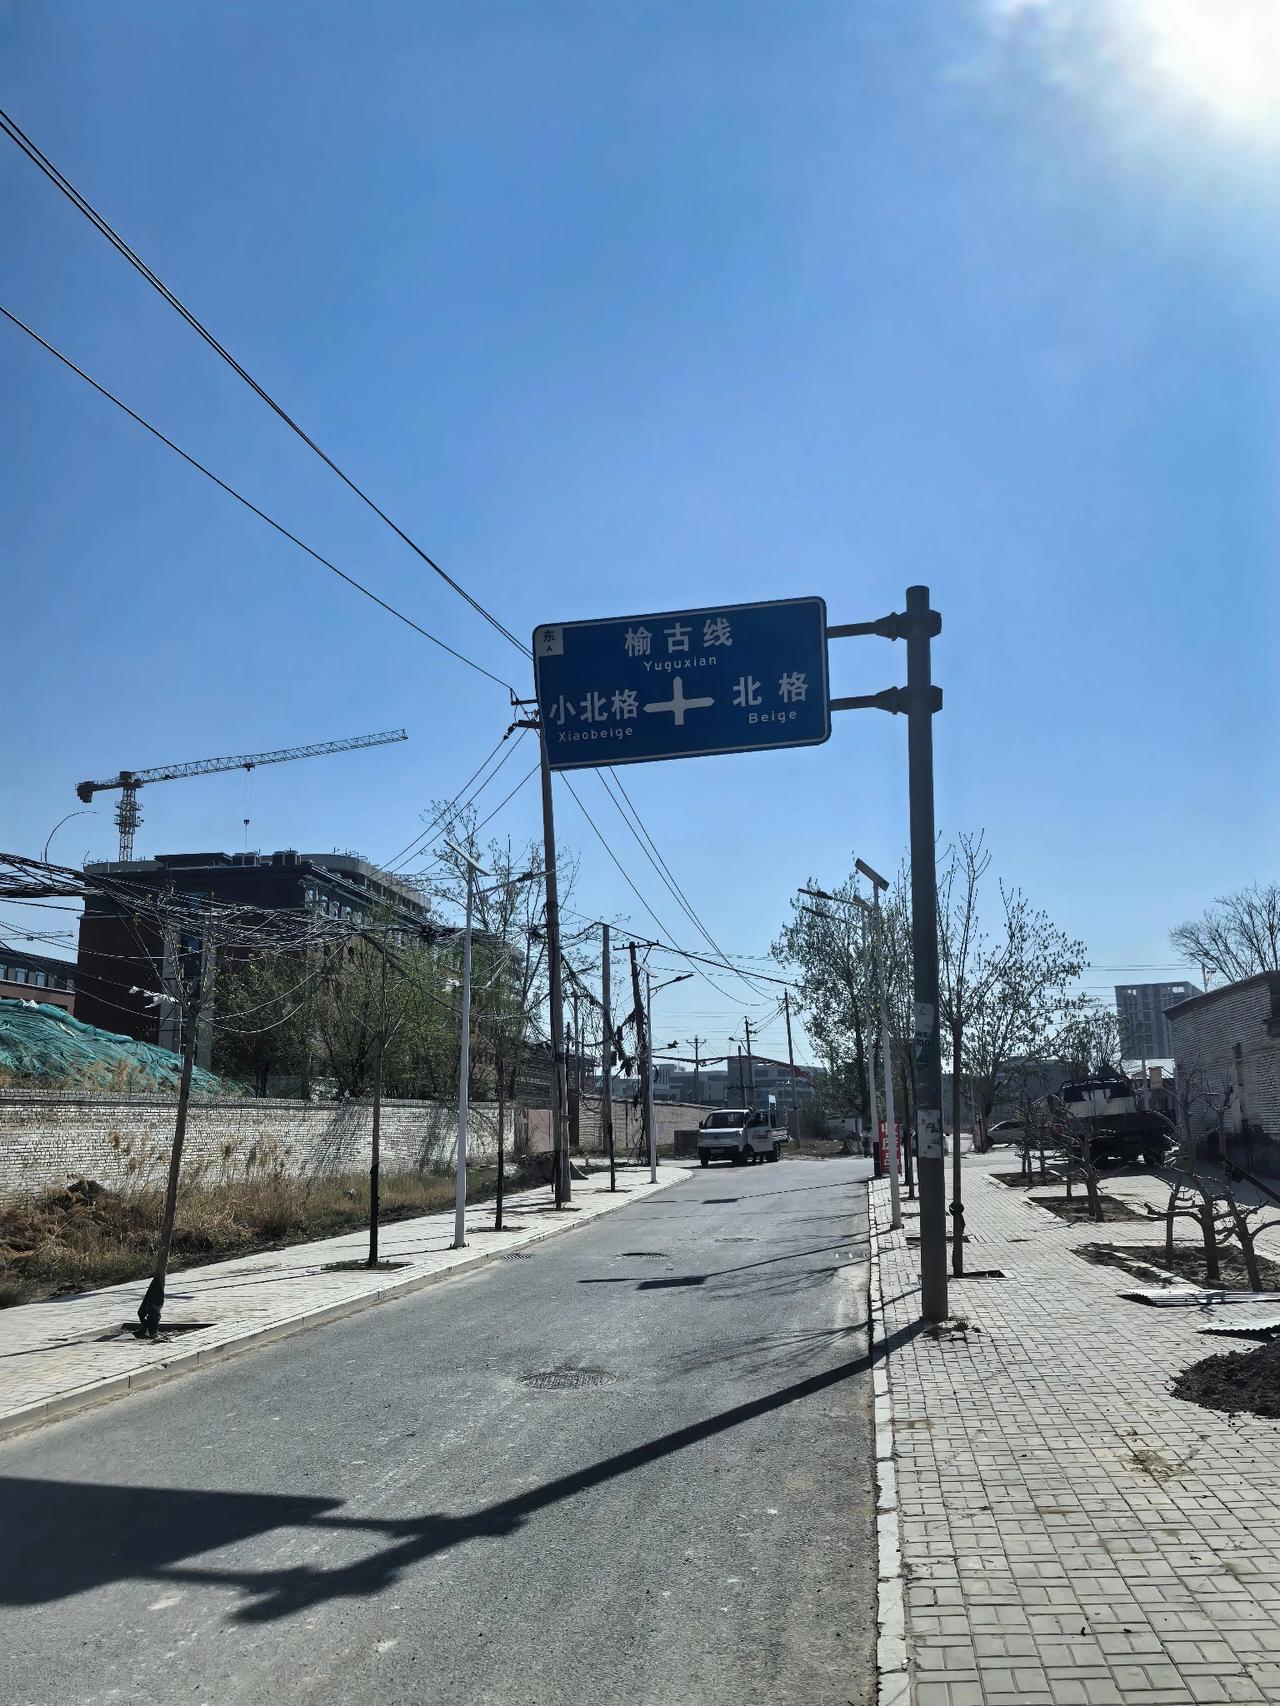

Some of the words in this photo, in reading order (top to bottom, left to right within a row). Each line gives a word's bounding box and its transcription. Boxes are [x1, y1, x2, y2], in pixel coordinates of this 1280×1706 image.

[624, 617, 734, 657] 榆古线
[643, 655, 718, 673] Yuguxian
[732, 671, 809, 708] 北格
[549, 688, 640, 725] 小北格
[749, 709, 797, 725] Beige
[558, 725, 634, 743] Xiaobeige
